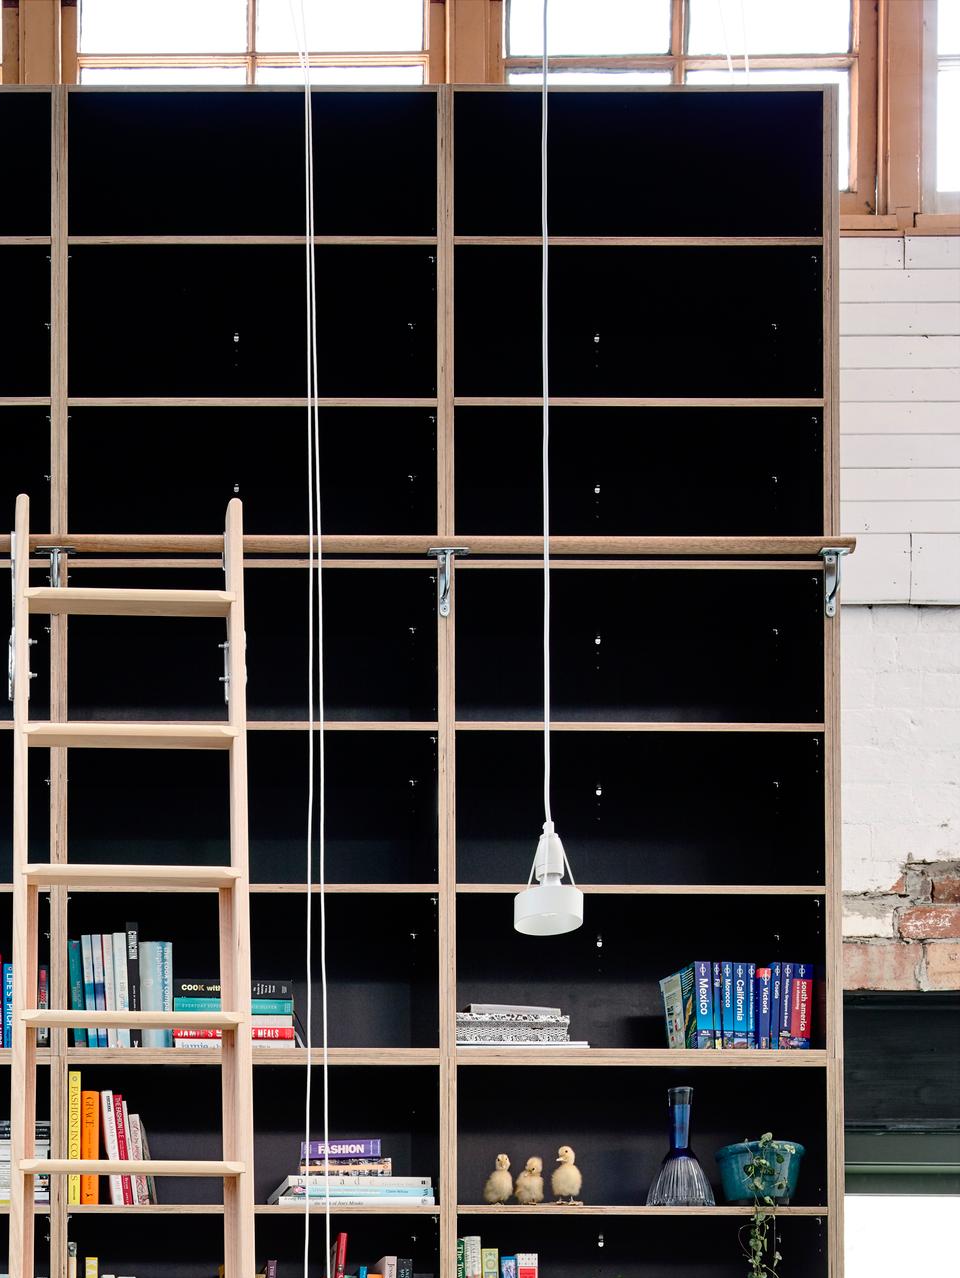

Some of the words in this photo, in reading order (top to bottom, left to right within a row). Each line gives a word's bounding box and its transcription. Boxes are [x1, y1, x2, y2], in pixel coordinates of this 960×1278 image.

[699, 978, 709, 1015] Mexico
[736, 979, 744, 1021] California
[800, 981, 808, 1002] south
[258, 1030, 279, 1038] MEALS
[71, 1086, 79, 1127] FASHION
[114, 1097, 122, 1106] THE
[85, 1097, 96, 1128] GRACE
[115, 1106, 123, 1126] FASHION
[318, 1144, 365, 1154] FASHION
